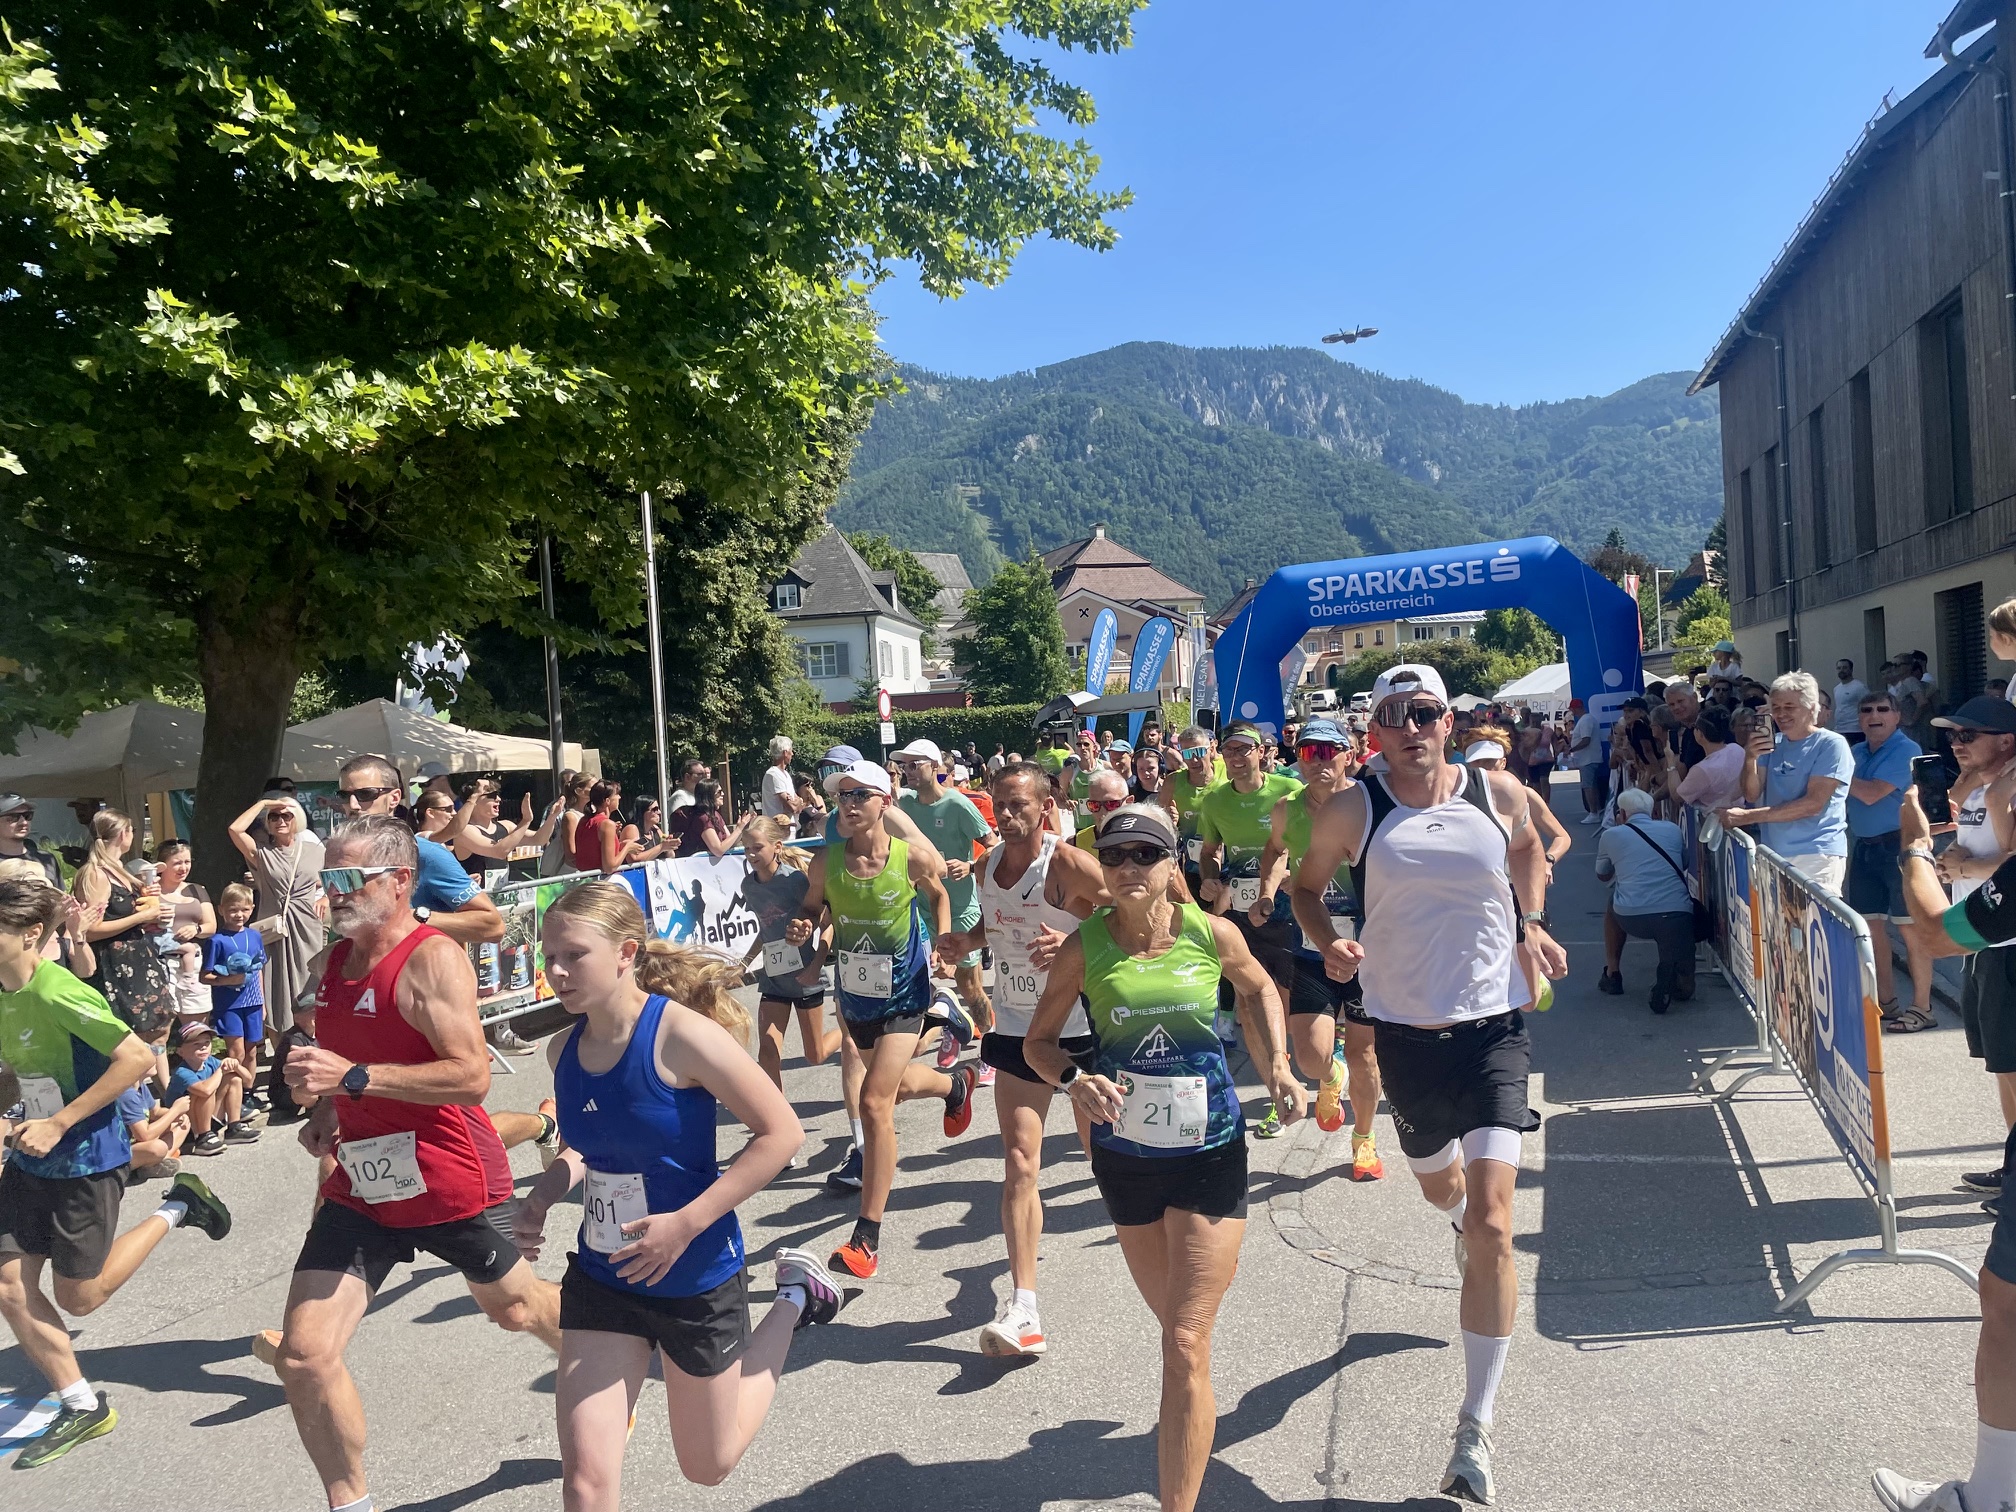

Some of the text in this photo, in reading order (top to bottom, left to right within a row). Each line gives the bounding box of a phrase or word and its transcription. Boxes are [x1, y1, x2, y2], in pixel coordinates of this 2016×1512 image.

[1308, 560, 1485, 601] SPARKASSE
[1310, 593, 1434, 617] Oberösterreich
[1090, 624, 1110, 685] SPARKASSE
[1134, 634, 1163, 692] SPARKASSE
[1143, 655, 1162, 692] berösterreich
[1196, 660, 1208, 707] MELASAN
[1241, 888, 1257, 901] 63
[707, 913, 758, 948] alpin
[770, 951, 783, 965] 37
[858, 966, 867, 982] 8
[1010, 975, 1036, 993] 109
[1132, 1003, 1200, 1016] PIESSLINGER
[1132, 1055, 1185, 1065] NATIONALPARK
[1143, 1102, 1172, 1127] 21
[350, 1157, 395, 1183] 102
[588, 1195, 617, 1225] 401
